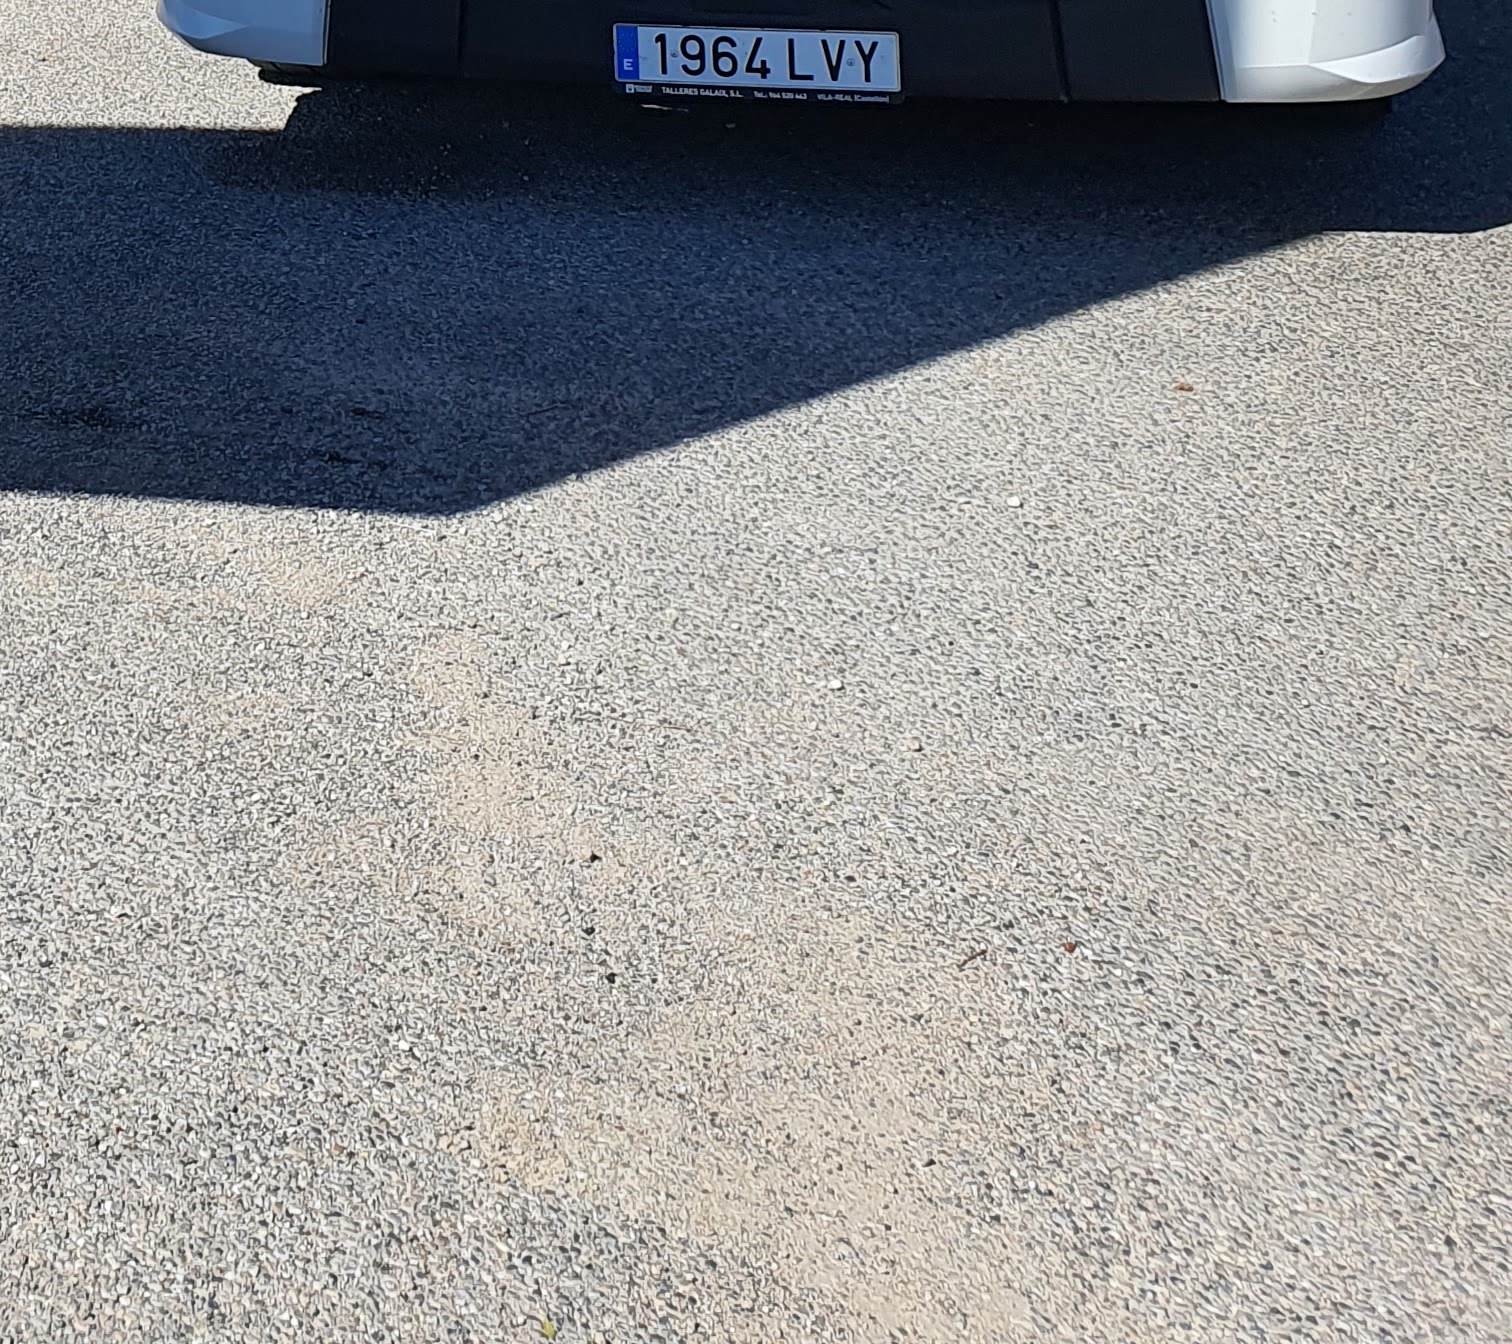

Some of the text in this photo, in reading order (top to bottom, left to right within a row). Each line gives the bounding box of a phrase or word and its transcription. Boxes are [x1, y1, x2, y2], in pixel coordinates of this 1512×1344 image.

[623, 58, 634, 70] E
[654, 33, 879, 83] 1964 LVY
[661, 86, 698, 95] TALLERES
